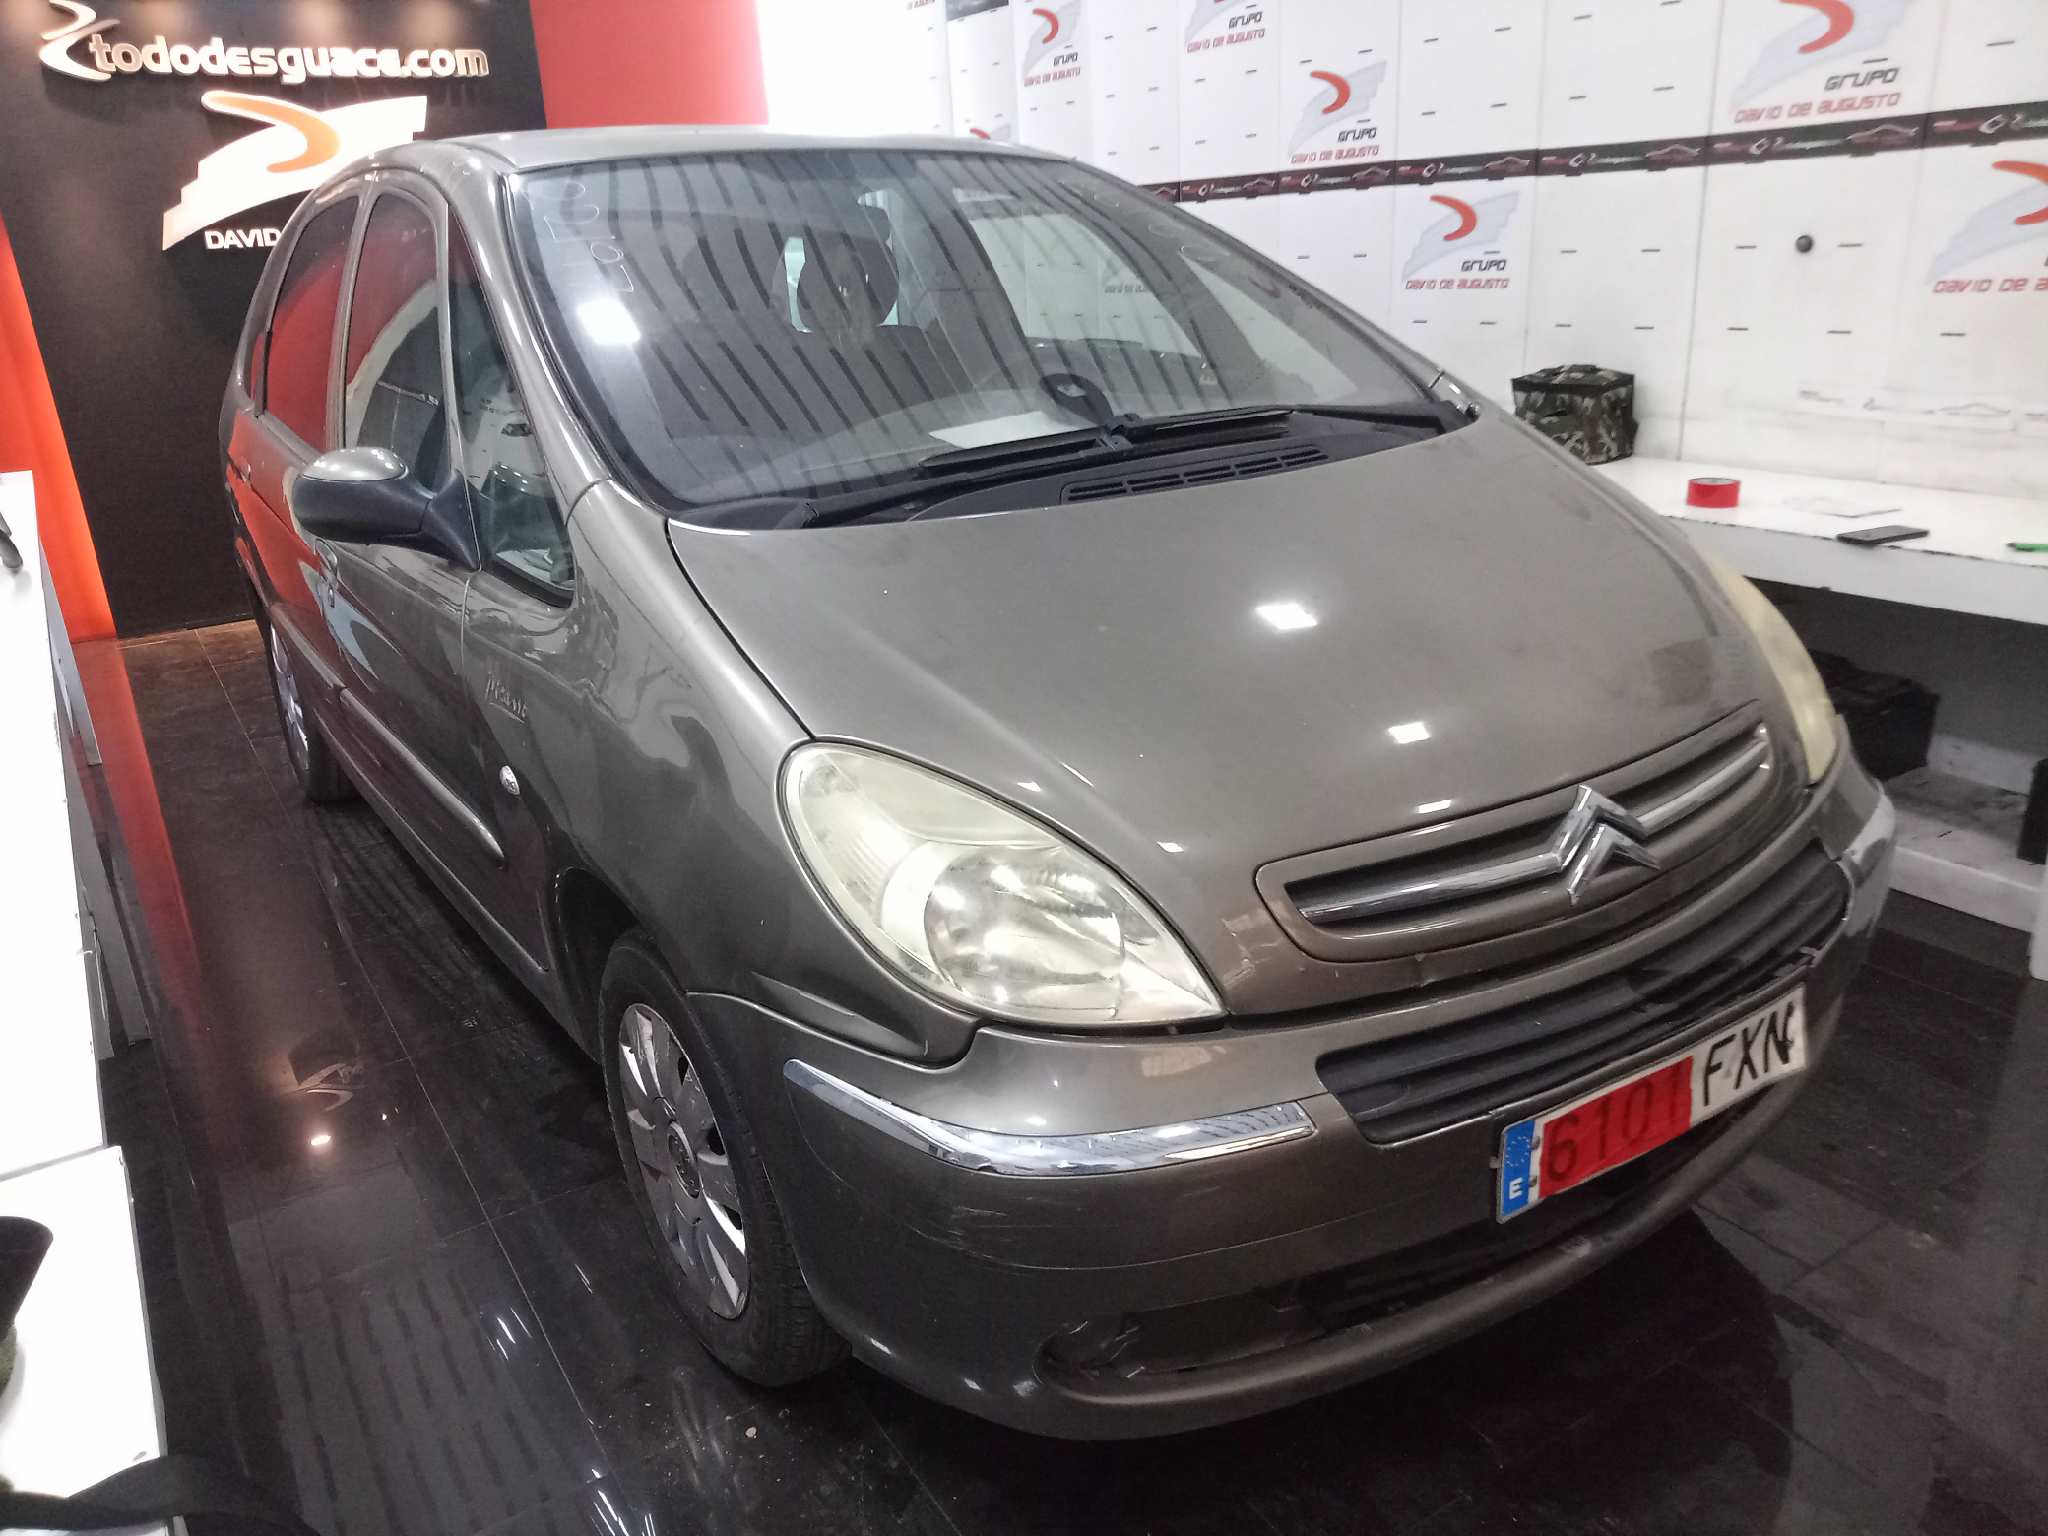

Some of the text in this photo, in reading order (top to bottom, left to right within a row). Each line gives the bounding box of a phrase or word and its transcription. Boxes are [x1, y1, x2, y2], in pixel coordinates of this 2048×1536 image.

[89, 33, 489, 85] tododesguace.com
[204, 227, 282, 250] DAVID
[1508, 1002, 1795, 1200] E 6101 FXN
